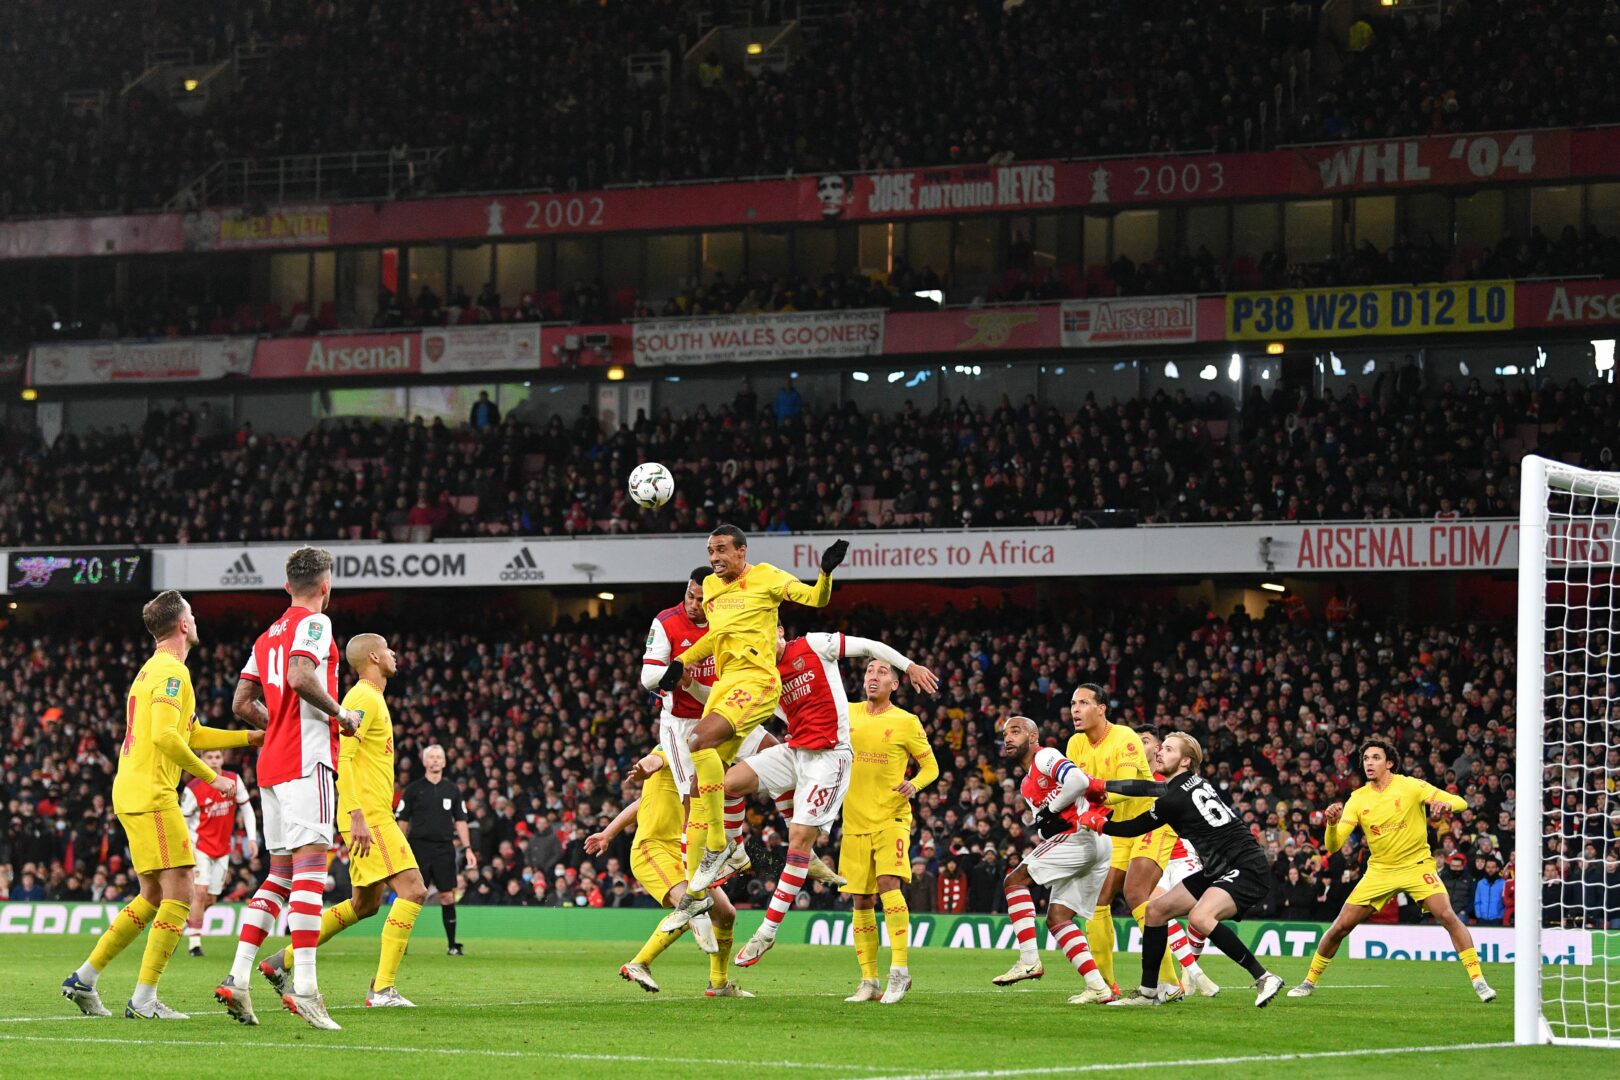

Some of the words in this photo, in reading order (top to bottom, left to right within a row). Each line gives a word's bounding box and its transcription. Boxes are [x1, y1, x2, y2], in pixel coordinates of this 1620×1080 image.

[1135, 162, 1224, 196] 2003
[1318, 142, 1431, 189] WHL
[868, 173, 915, 212] JOSE
[917, 182, 994, 209] ANTONIO
[997, 166, 1055, 205] REYES
[525, 197, 604, 229] 2002
[1095, 298, 1192, 331] Arsenal
[1232, 296, 1294, 333] P38
[1306, 292, 1378, 331] W26
[1391, 288, 1455, 327] D12
[636, 332, 703, 352] SOUTH
[710, 327, 775, 349] WALES
[782, 323, 880, 345] GOONERS
[304, 336, 410, 372] Arsenal
[838, 543, 938, 568] mirates
[947, 545, 971, 566] to
[979, 539, 1055, 565] Africa
[1297, 523, 1609, 569] ARSENAL.COM/URS
[220, 574, 263, 586] adidas
[331, 554, 466, 577] IDAS.COM
[499, 568, 545, 581] adidas
[781, 670, 816, 696] mirates
[806, 784, 829, 808] 18
[895, 838, 904, 859] 9
[1141, 830, 1153, 845] 4
